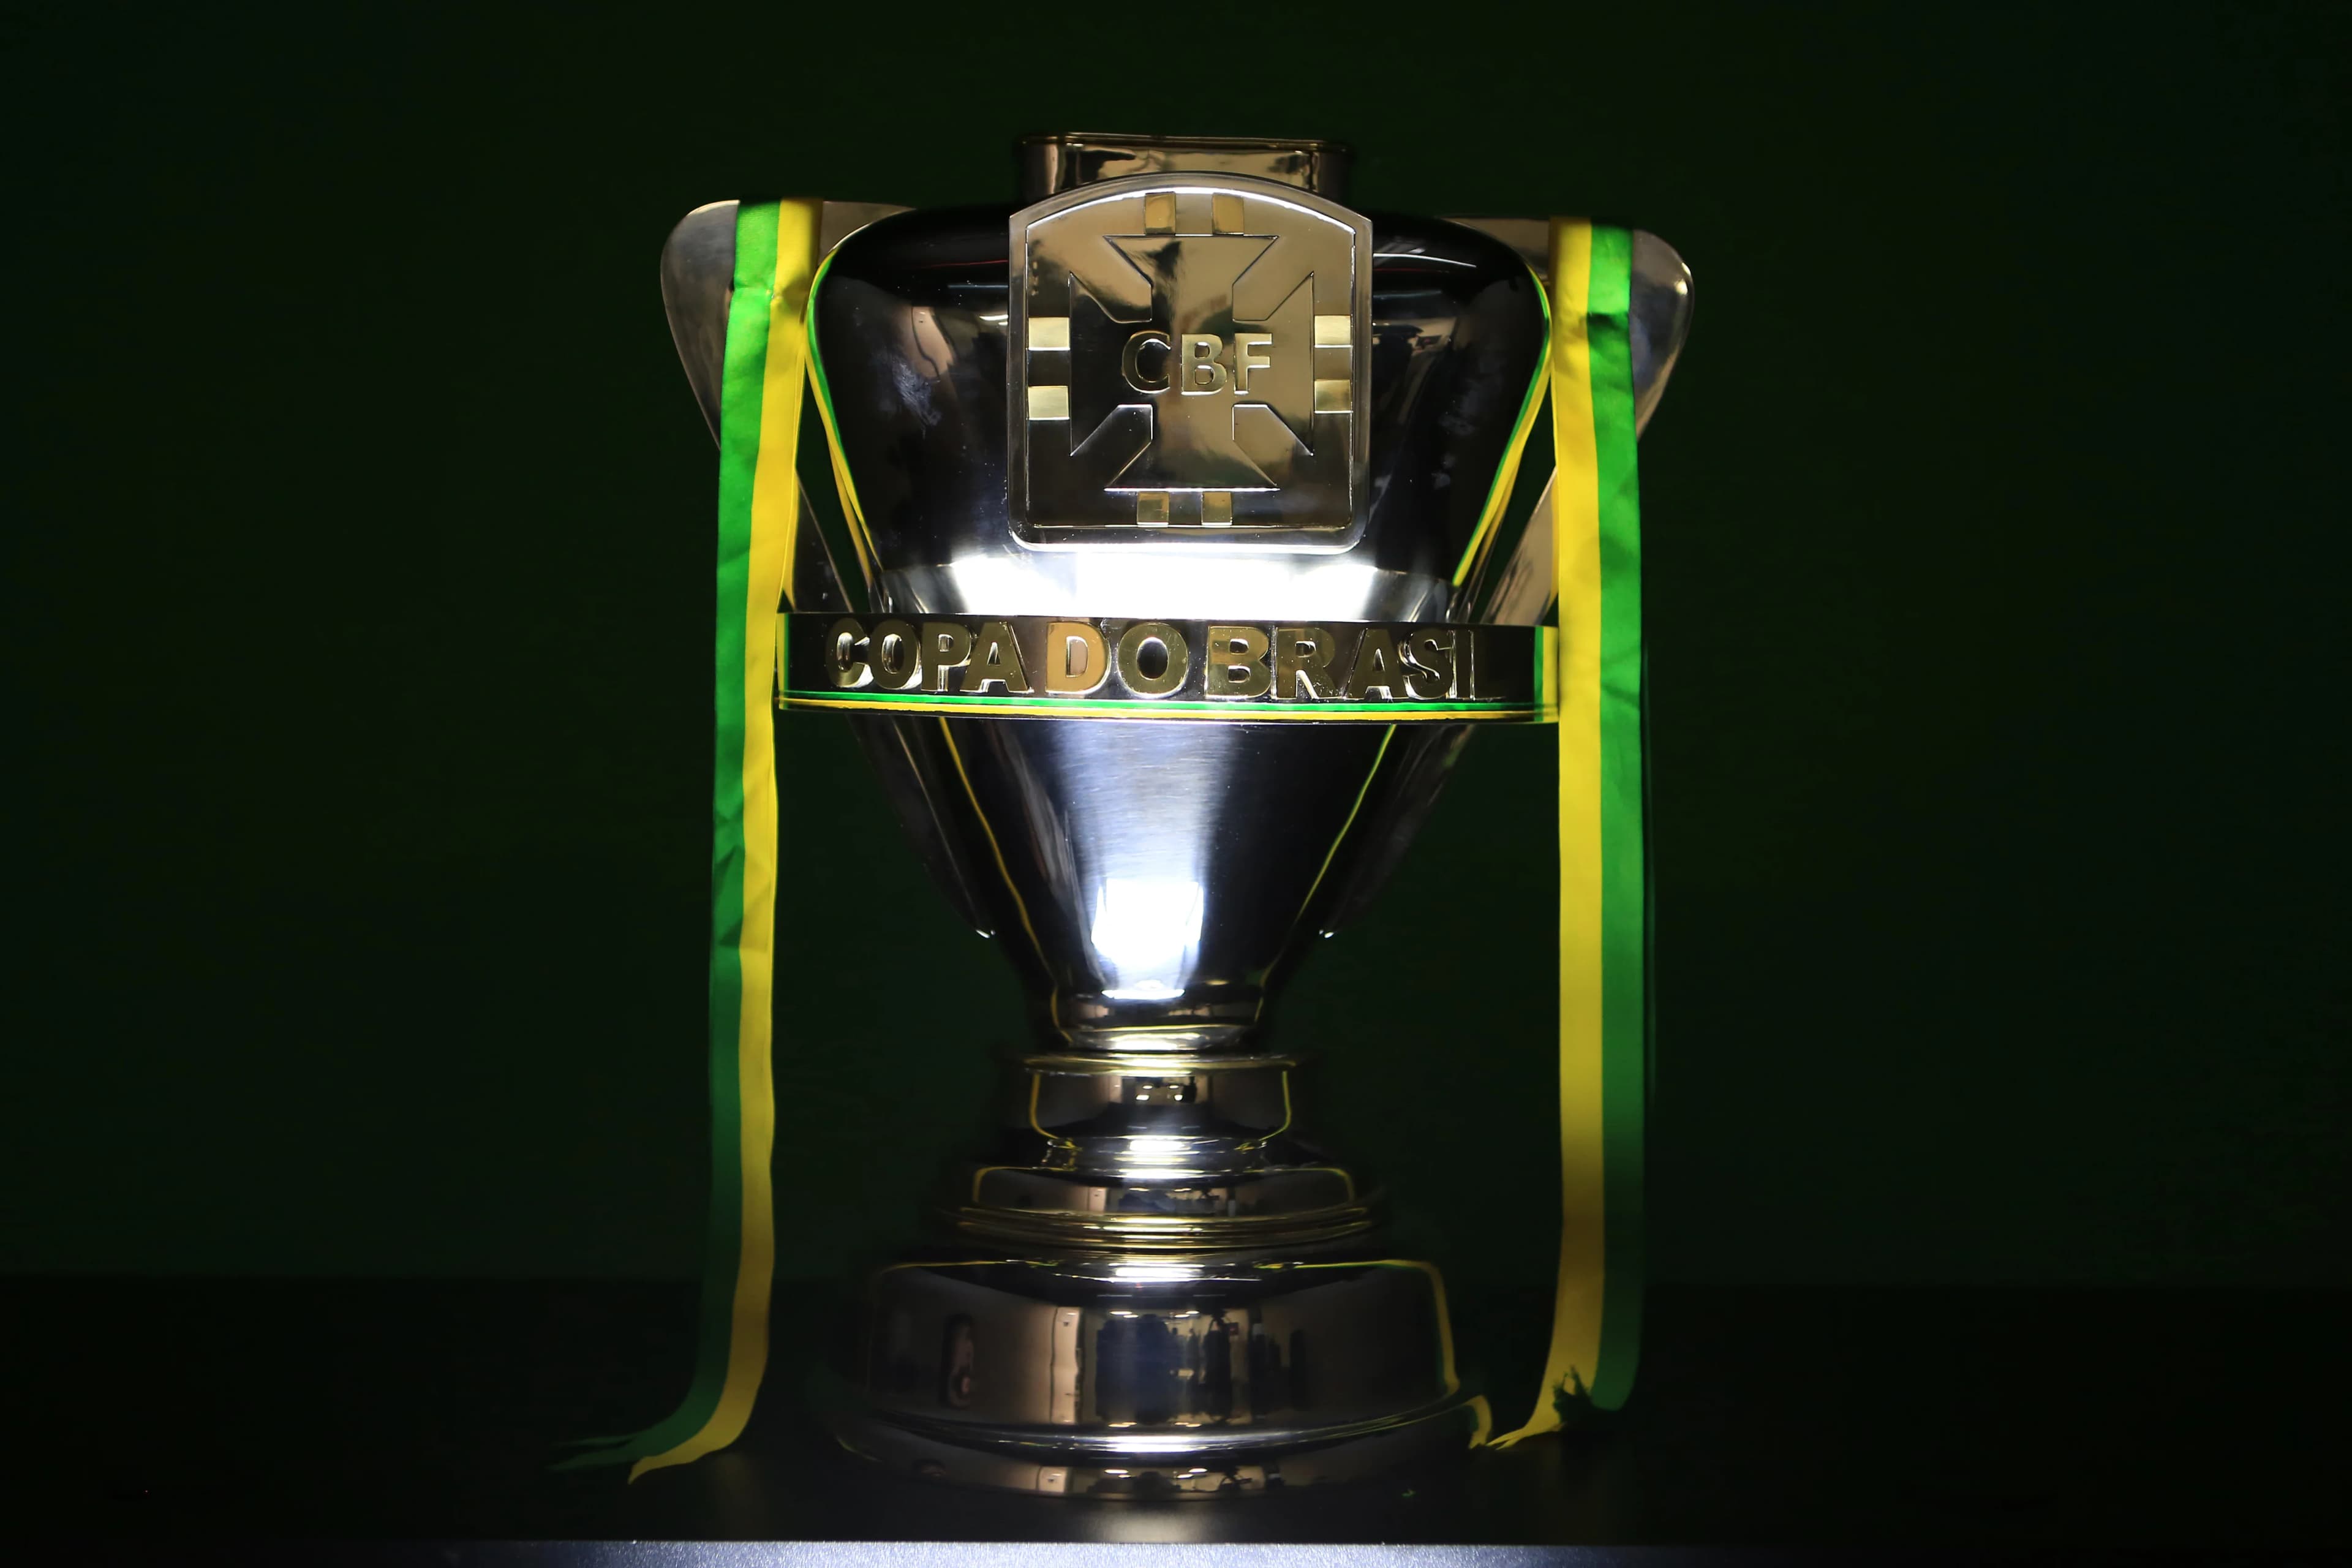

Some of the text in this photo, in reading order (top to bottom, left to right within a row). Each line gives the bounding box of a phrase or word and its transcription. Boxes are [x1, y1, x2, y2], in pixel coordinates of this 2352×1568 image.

[1122, 330, 1273, 395] CBF
[826, 618, 1034, 695] COPA
[1045, 621, 1188, 698] DO
